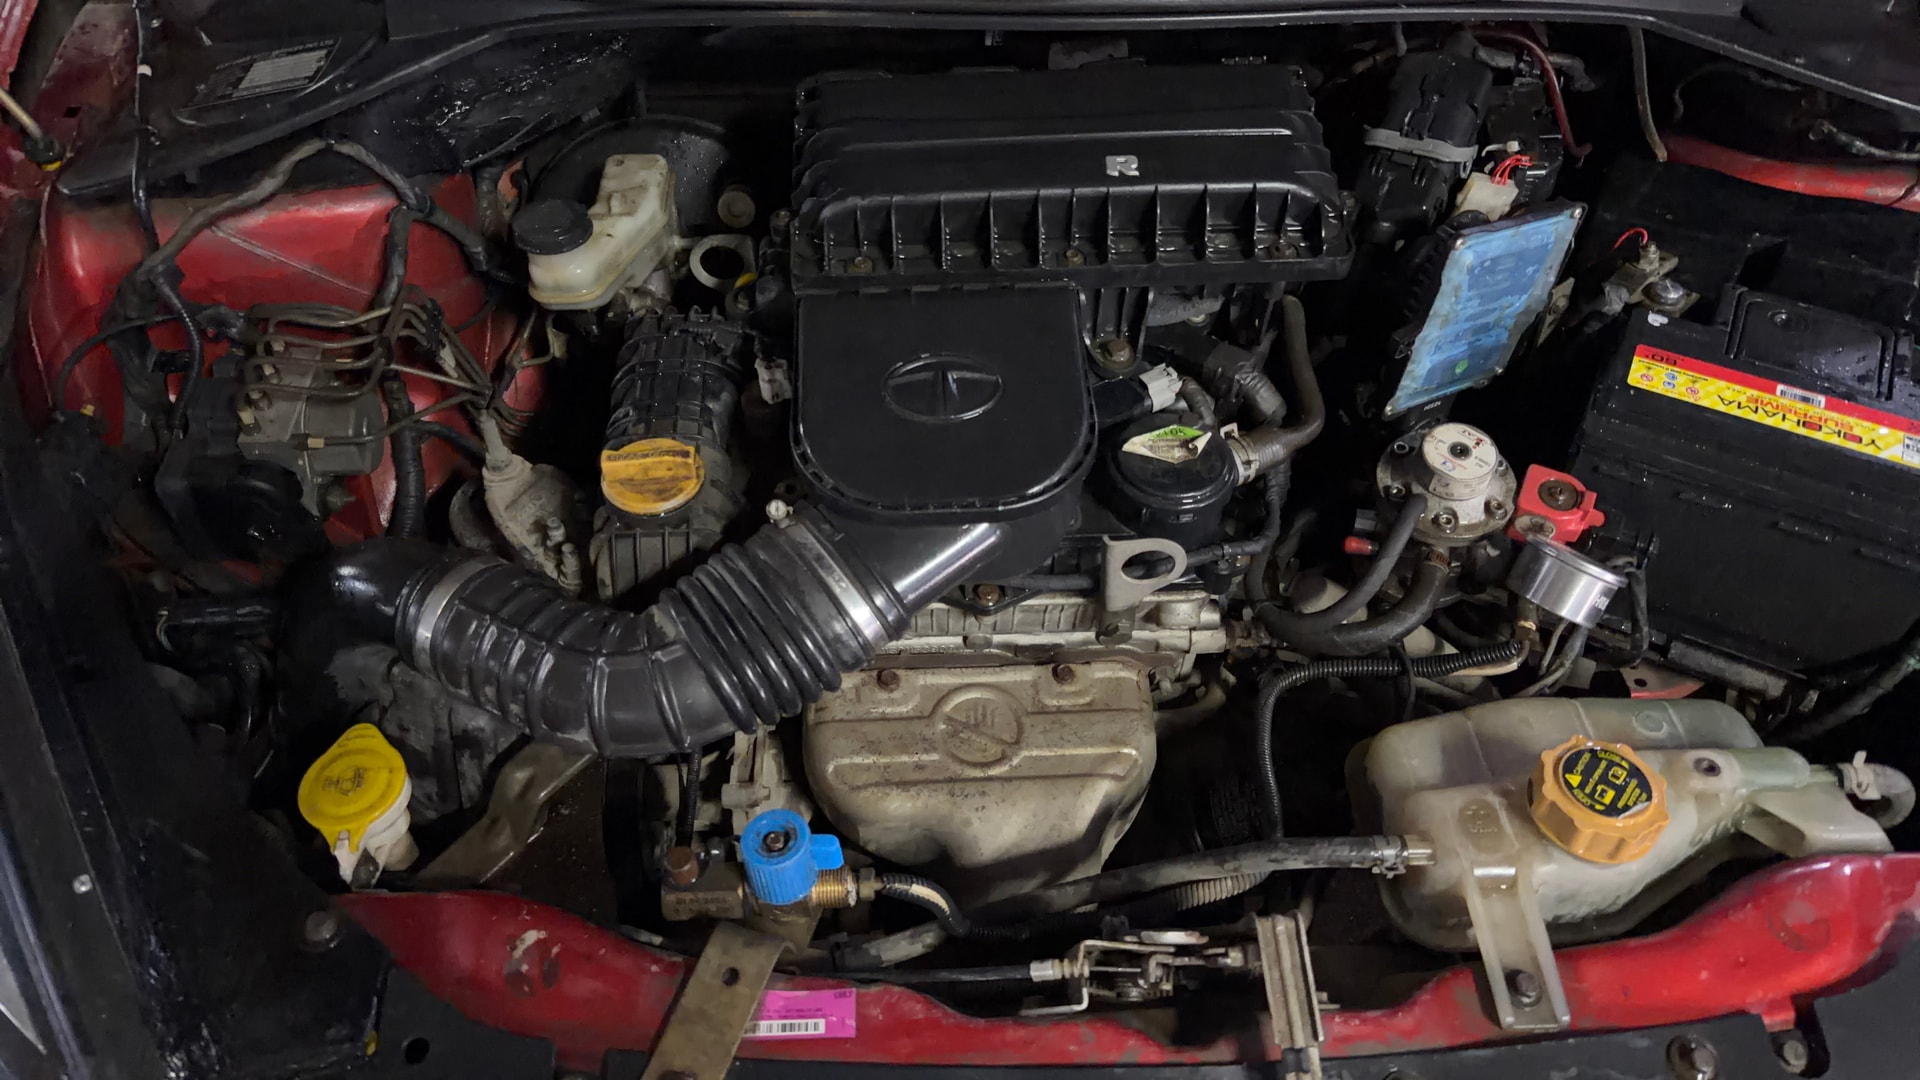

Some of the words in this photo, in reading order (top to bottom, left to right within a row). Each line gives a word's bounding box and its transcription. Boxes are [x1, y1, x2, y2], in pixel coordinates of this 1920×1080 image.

[1105, 154, 1140, 177] R
[1716, 394, 1882, 451] YOKOHAMA
[1746, 395, 1854, 433] SUPREME
